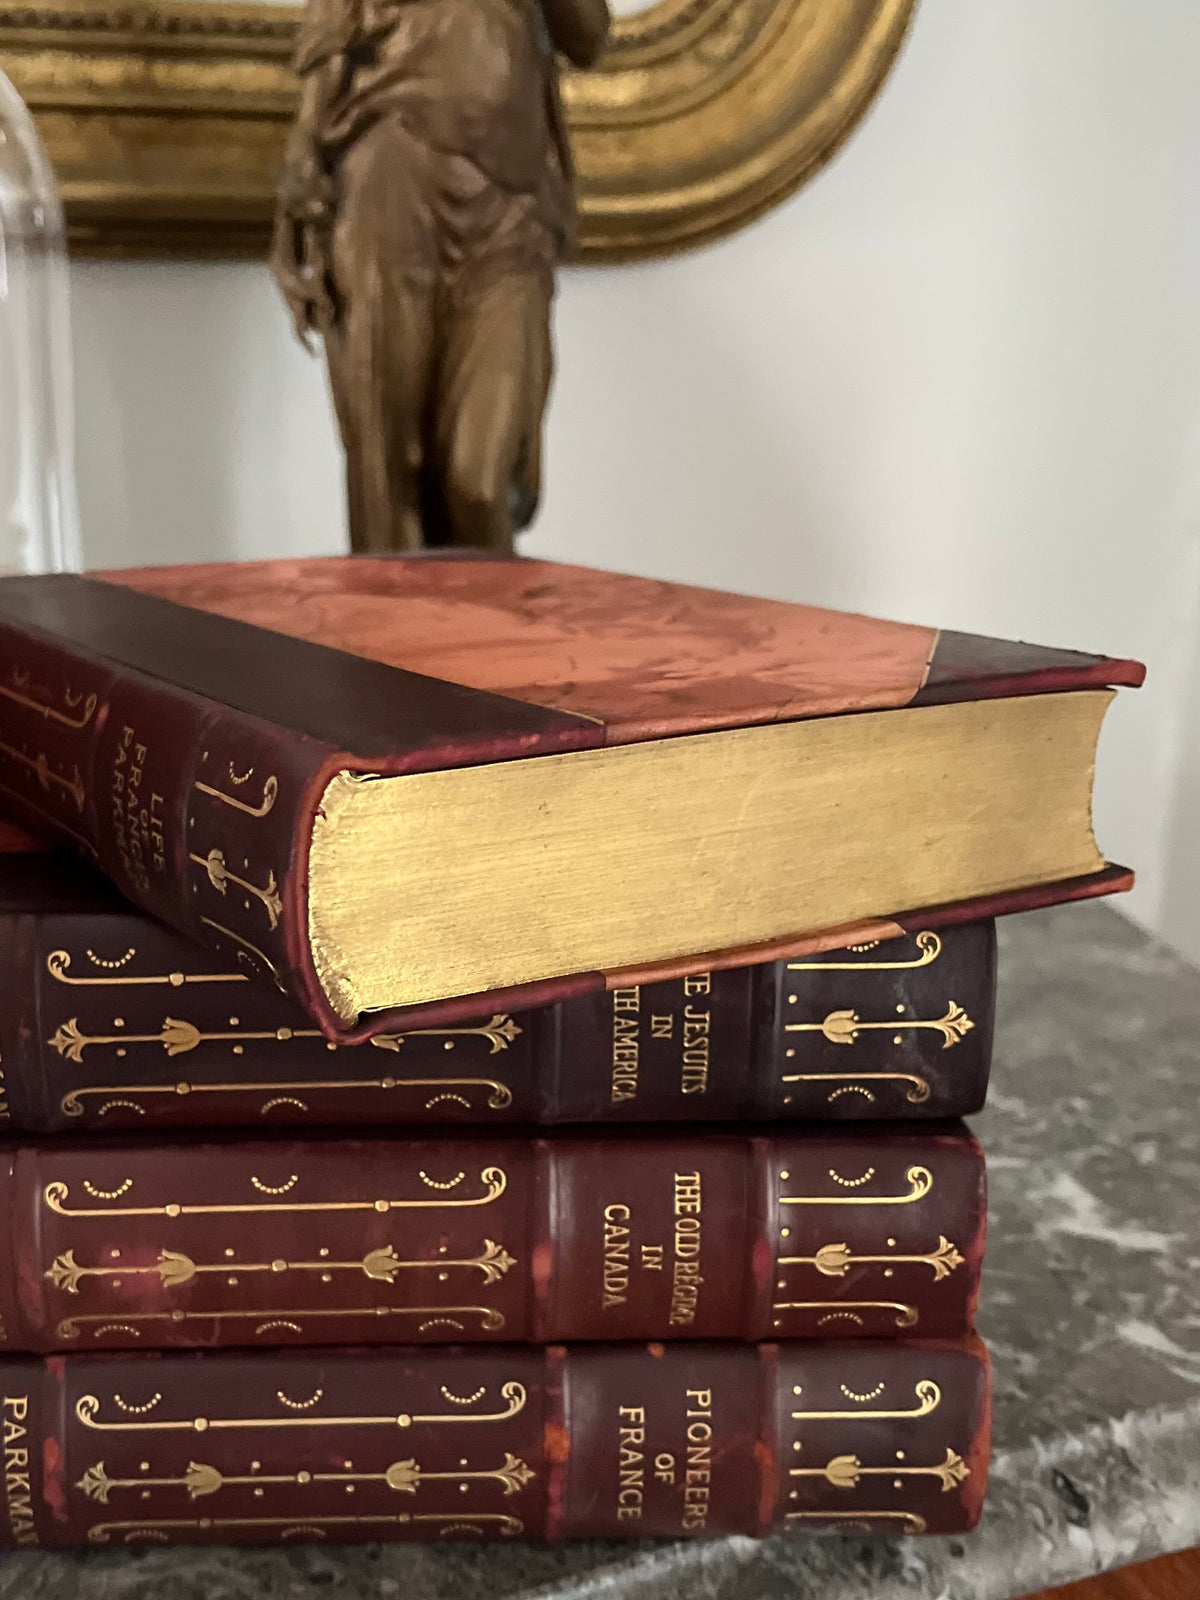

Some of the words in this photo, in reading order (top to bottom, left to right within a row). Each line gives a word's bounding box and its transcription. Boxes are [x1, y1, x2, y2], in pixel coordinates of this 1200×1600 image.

[150, 792, 166, 873] LIFE
[612, 1015, 640, 1102] AMERICA
[652, 1013, 673, 1040] IN
[682, 1005, 710, 1096] JESUITS
[674, 1171, 702, 1215] THE
[603, 1203, 631, 1311] CANADA
[641, 1244, 663, 1271] IN
[675, 1217, 702, 1259] OLD
[618, 1406, 645, 1520] FRANCE
[654, 1452, 675, 1485] OF
[682, 1388, 712, 1529] PIONEERS
